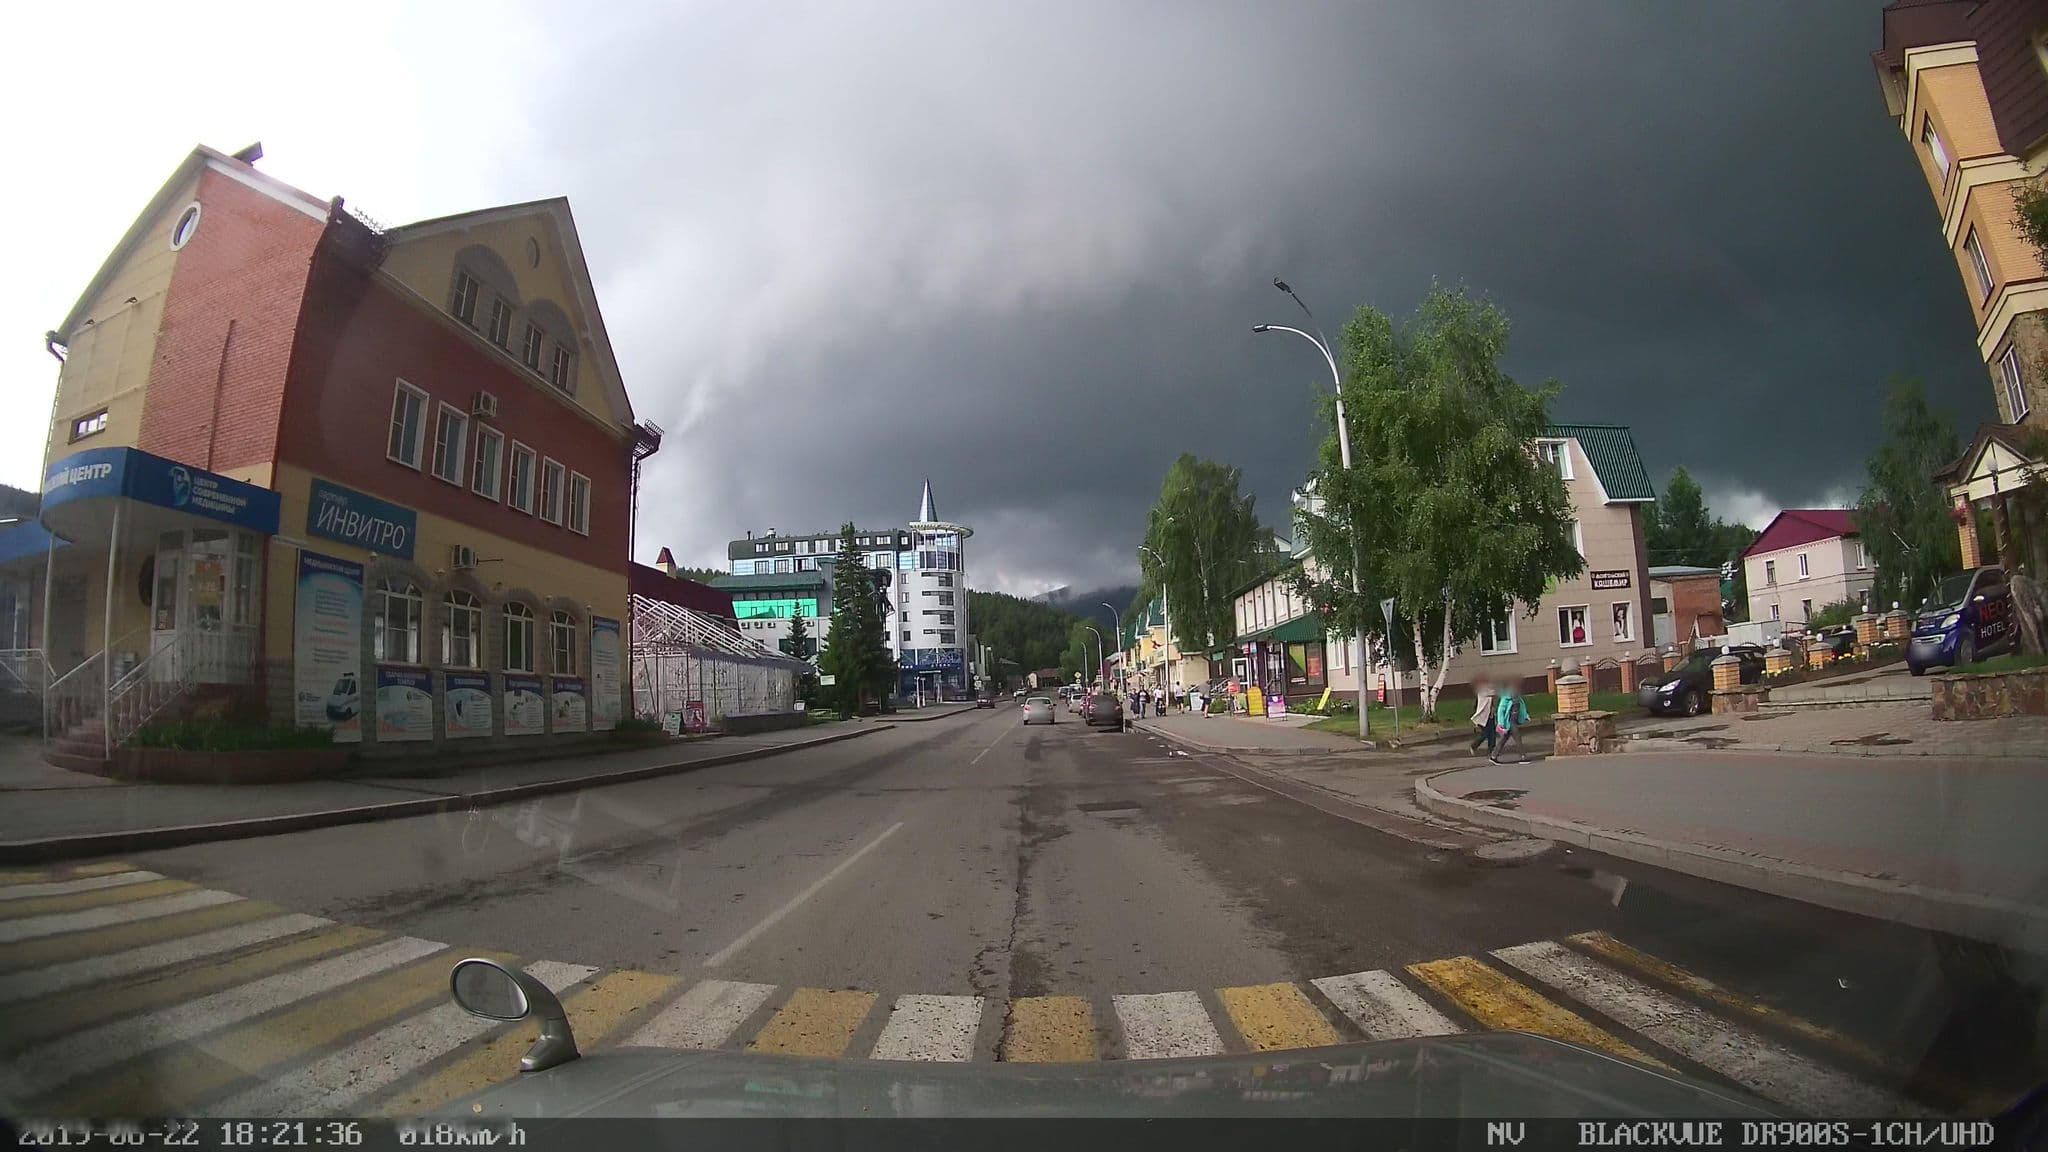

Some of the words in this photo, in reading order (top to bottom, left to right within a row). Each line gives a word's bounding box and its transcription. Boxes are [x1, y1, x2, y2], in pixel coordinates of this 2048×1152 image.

[69, 463, 112, 485] ЦЕНТР
[317, 502, 405, 550] ИНВИТРО
[1980, 621, 2006, 639] HOTEL
